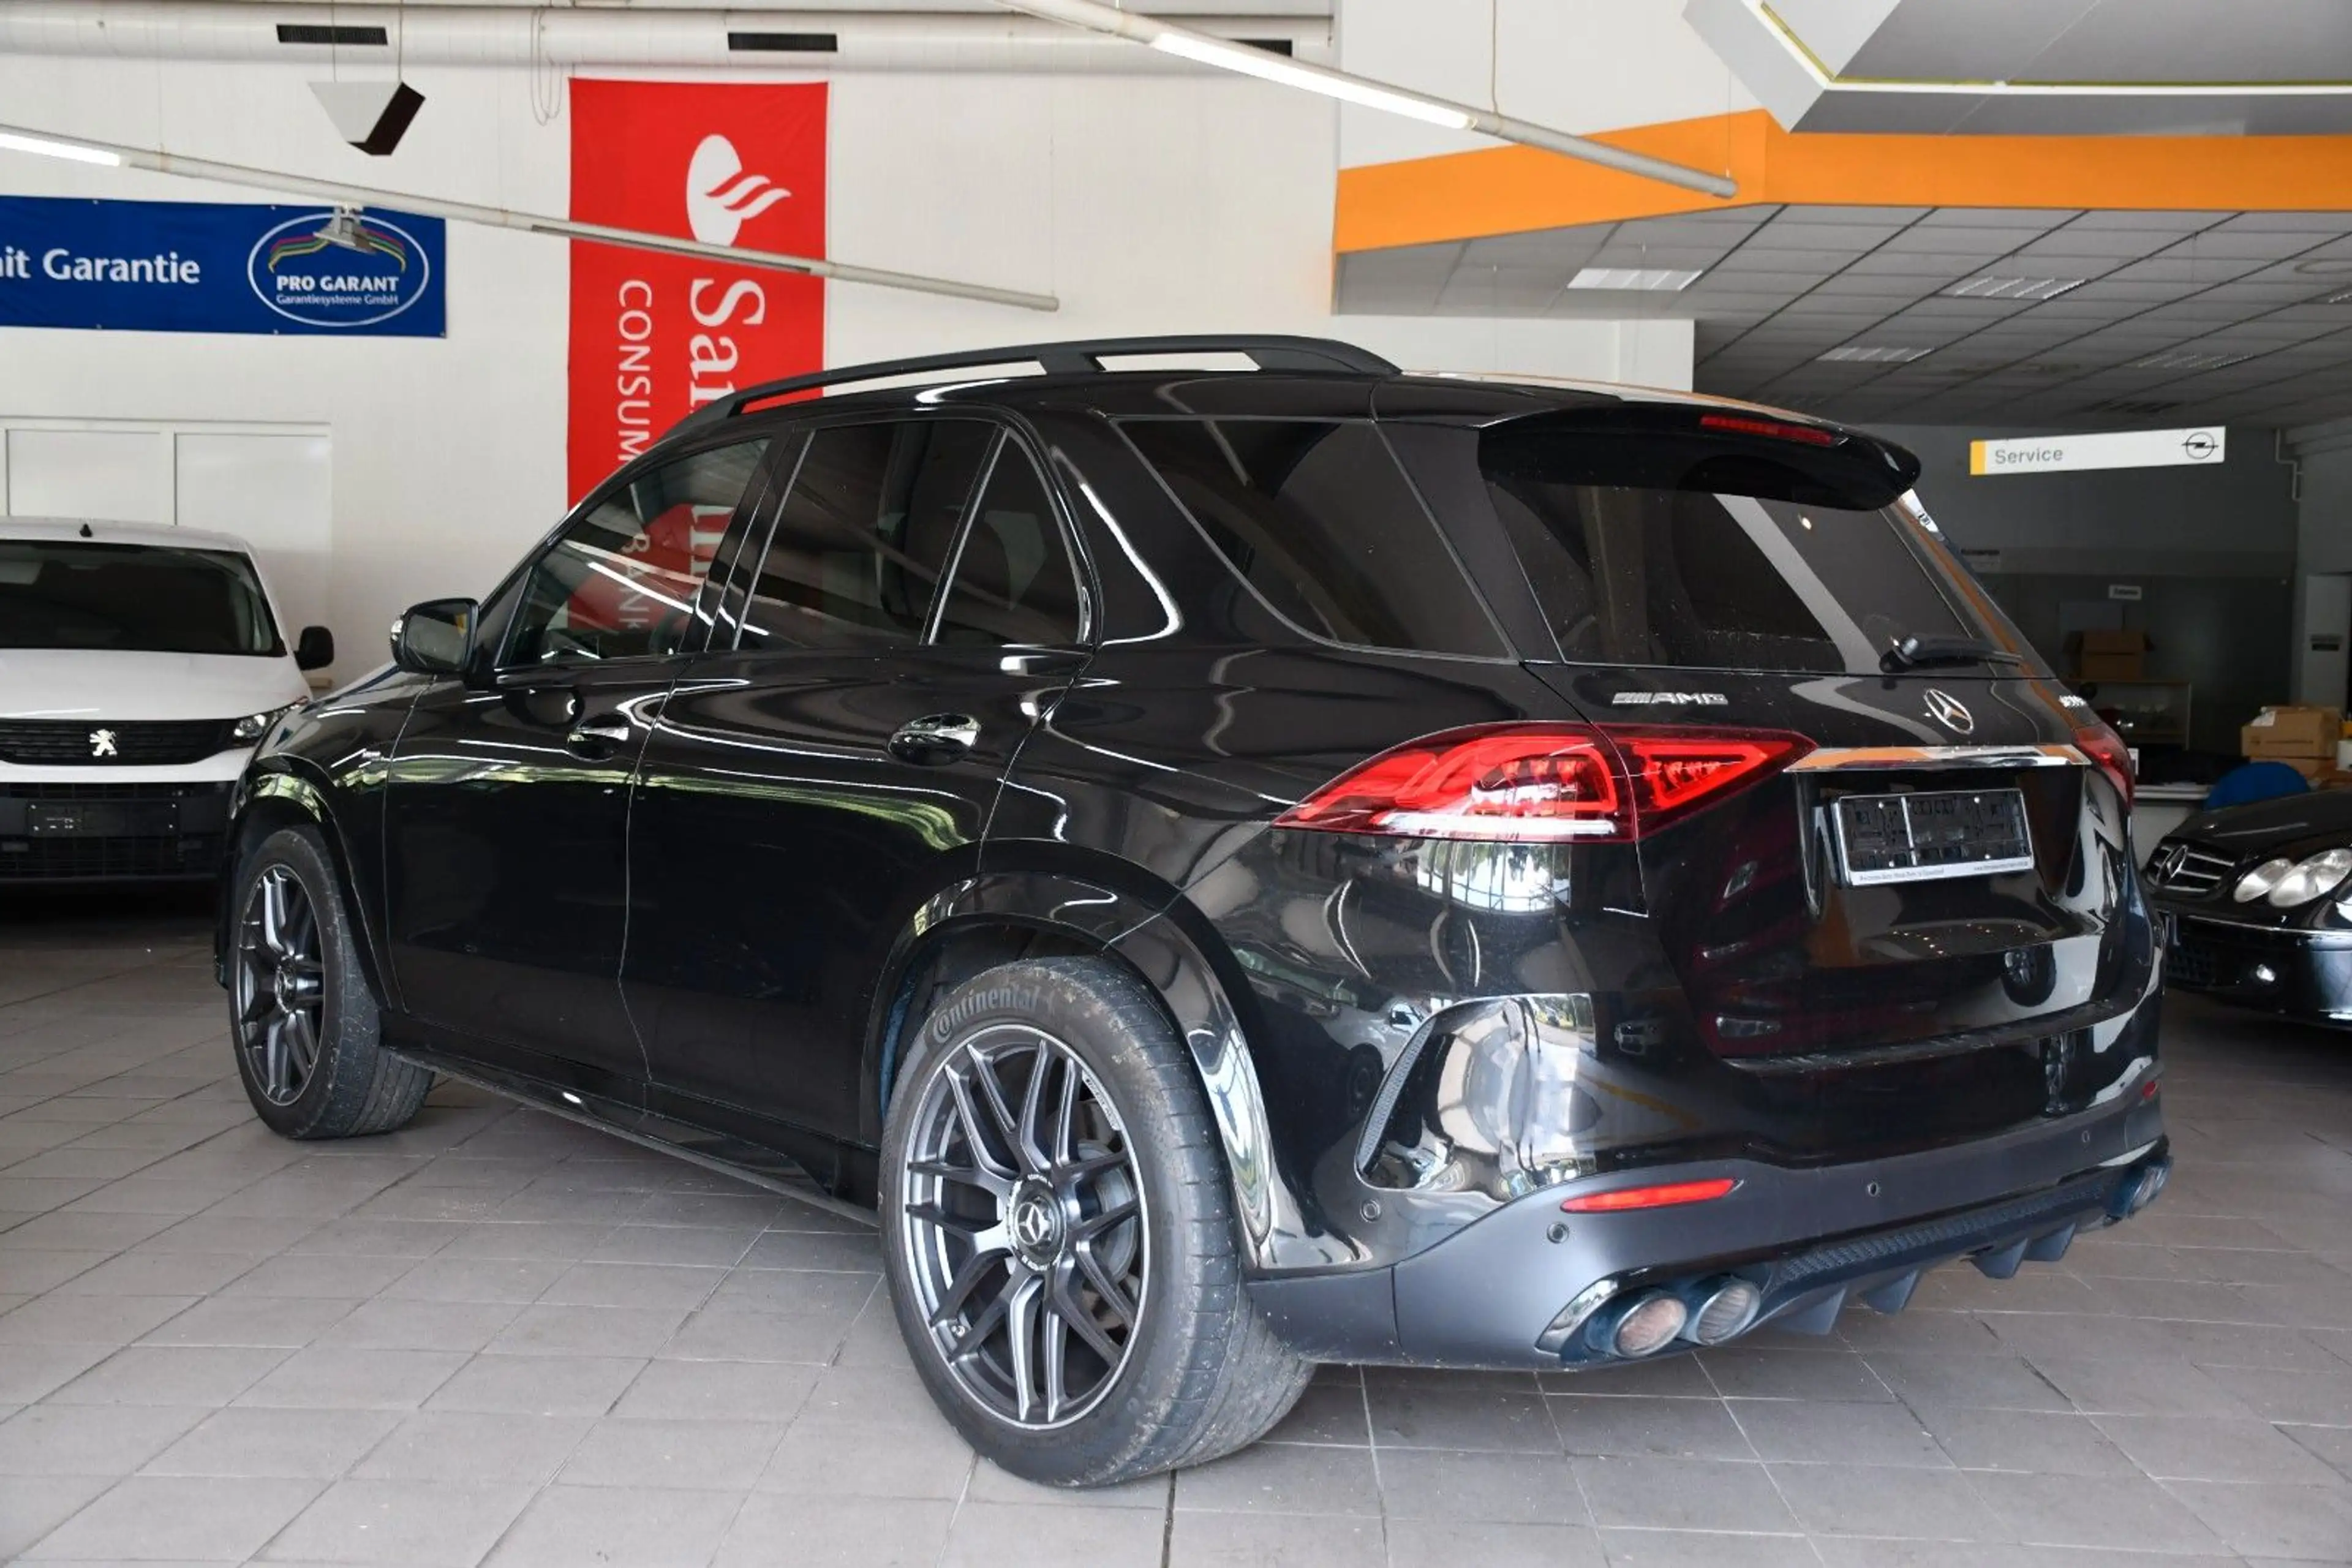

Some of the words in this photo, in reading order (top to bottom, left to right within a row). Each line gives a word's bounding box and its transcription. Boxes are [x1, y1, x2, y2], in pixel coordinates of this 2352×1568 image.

[0, 246, 31, 279] it
[42, 247, 201, 284] Garantie
[276, 276, 315, 292] PRO
[320, 276, 399, 292] GARANT
[276, 293, 363, 307] Garantiesysteme
[364, 294, 399, 305] GmbH
[1994, 447, 2064, 465] Service
[1651, 692, 1728, 706] AMG
[933, 984, 1041, 1042] Continental
